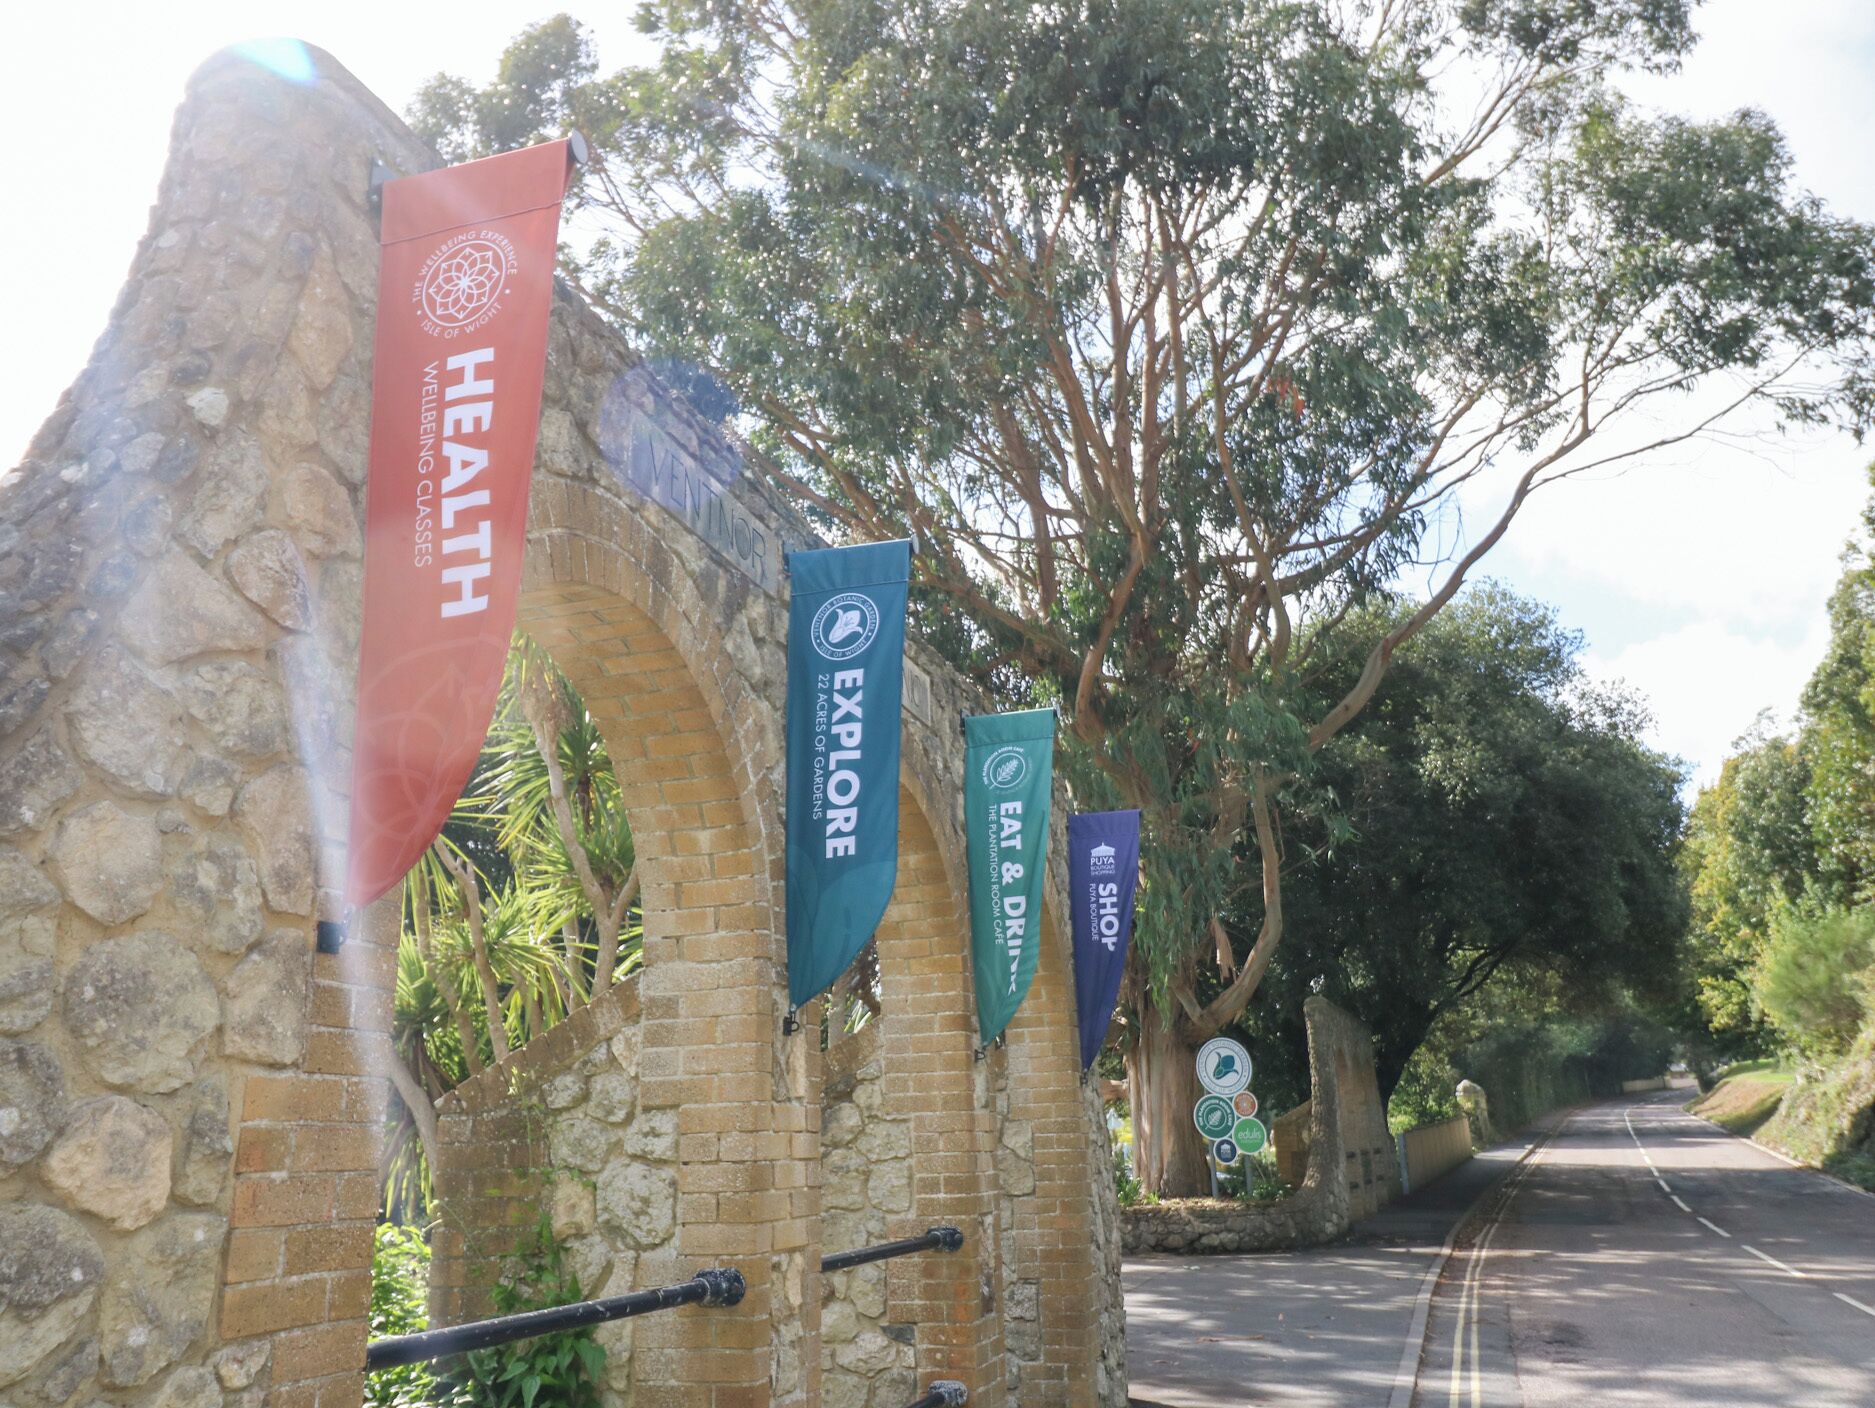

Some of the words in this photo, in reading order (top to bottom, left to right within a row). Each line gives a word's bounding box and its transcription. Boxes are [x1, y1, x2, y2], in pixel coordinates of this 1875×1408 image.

[412, 281, 424, 304] THE
[419, 230, 477, 276] WELLBEING
[480, 230, 517, 276] EXPERIENCE
[420, 319, 440, 337] ISLE
[444, 326, 460, 340] OF
[464, 302, 503, 335] WIGHT
[418, 360, 439, 474] WELLBEING
[441, 347, 494, 618] HEALTH
[414, 479, 433, 568] CLASSES
[650, 440, 768, 582] VENTNOR
[817, 673, 830, 689] 22
[815, 692, 828, 732] ACRES
[814, 735, 826, 753] OF
[826, 668, 864, 859] EXPLORE
[813, 756, 825, 820] GARDENS
[988, 804, 997, 822] THE
[1000, 800, 1022, 850] EAT
[988, 824, 998, 882] PLANTATION
[1001, 861, 1024, 887] &
[1090, 856, 1115, 866] PUYA
[991, 884, 1001, 917] ROOM
[1089, 883, 1097, 902] PUYA
[1089, 903, 1099, 942] BOUTIQUE
[1098, 882, 1119, 951] SHOP
